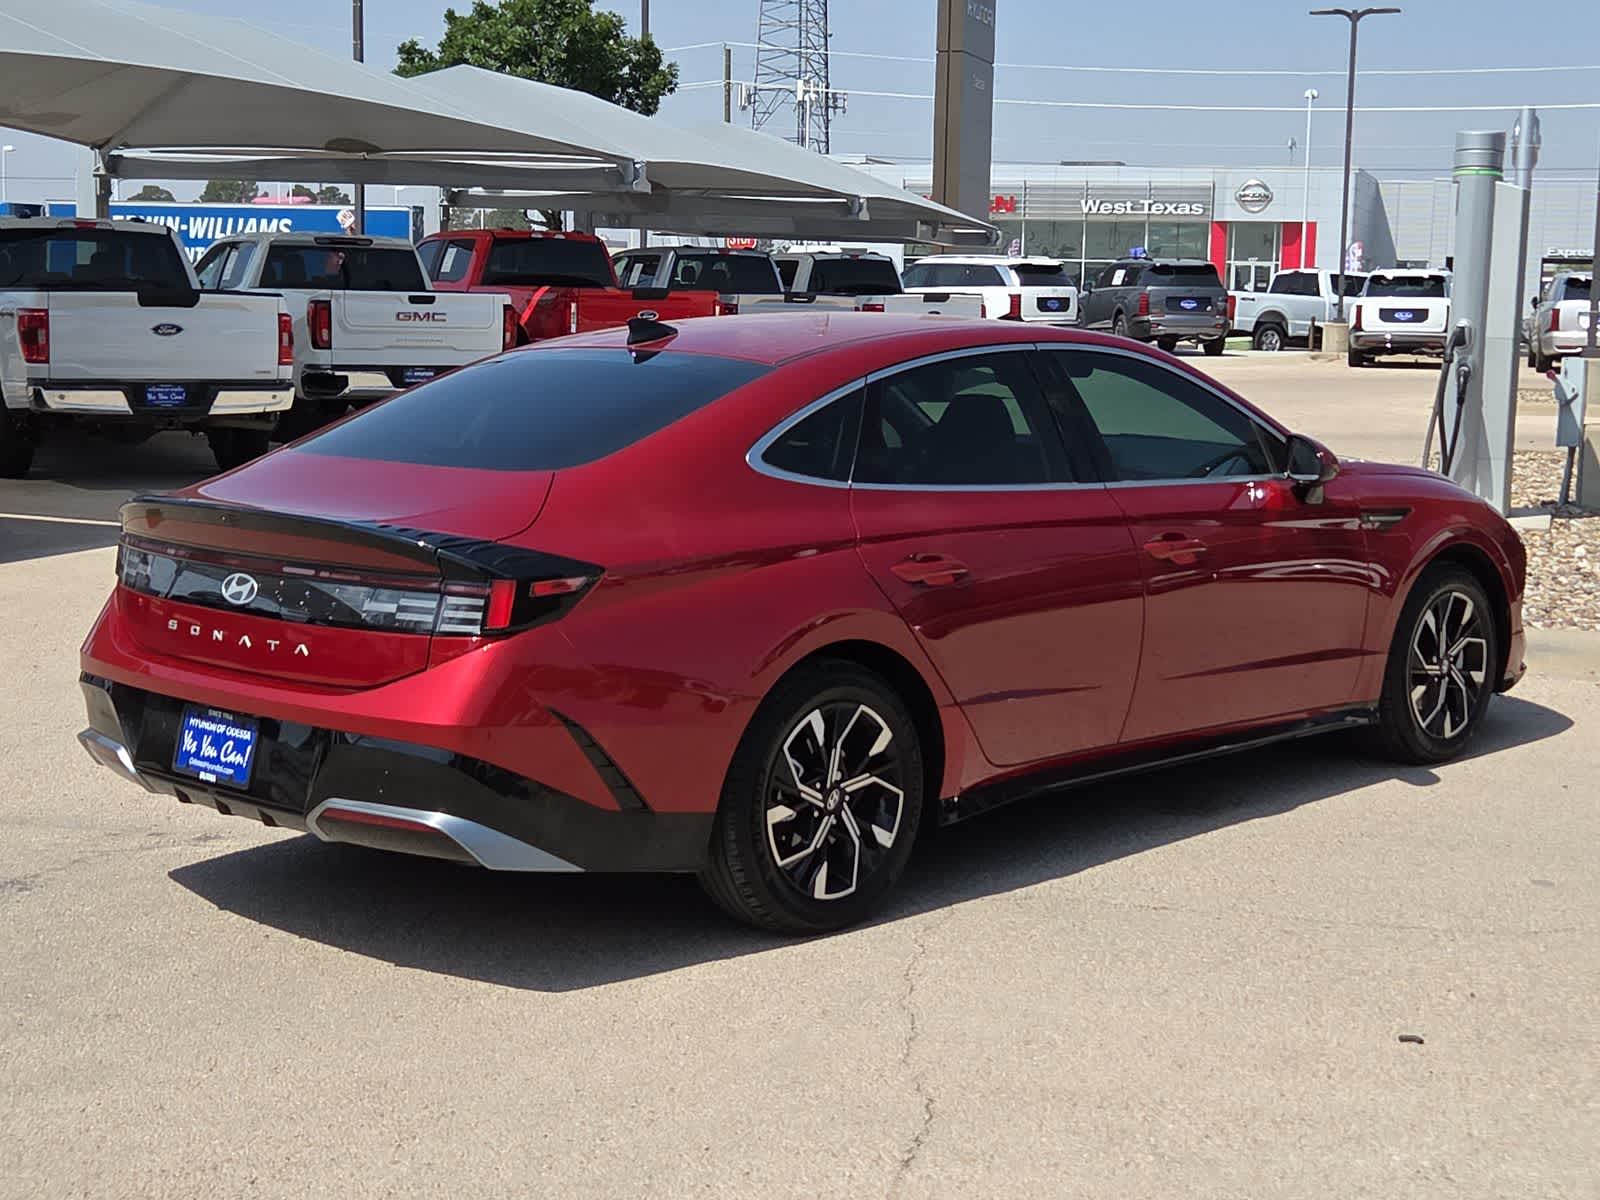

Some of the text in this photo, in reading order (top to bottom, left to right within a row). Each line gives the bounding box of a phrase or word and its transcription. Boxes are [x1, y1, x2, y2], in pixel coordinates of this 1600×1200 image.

[1080, 199, 1204, 215] West Texas
[1547, 247, 1595, 258] Expres
[396, 311, 447, 322] GMC
[167, 619, 309, 657] SONATA
[182, 729, 252, 769] Yes You Can!
